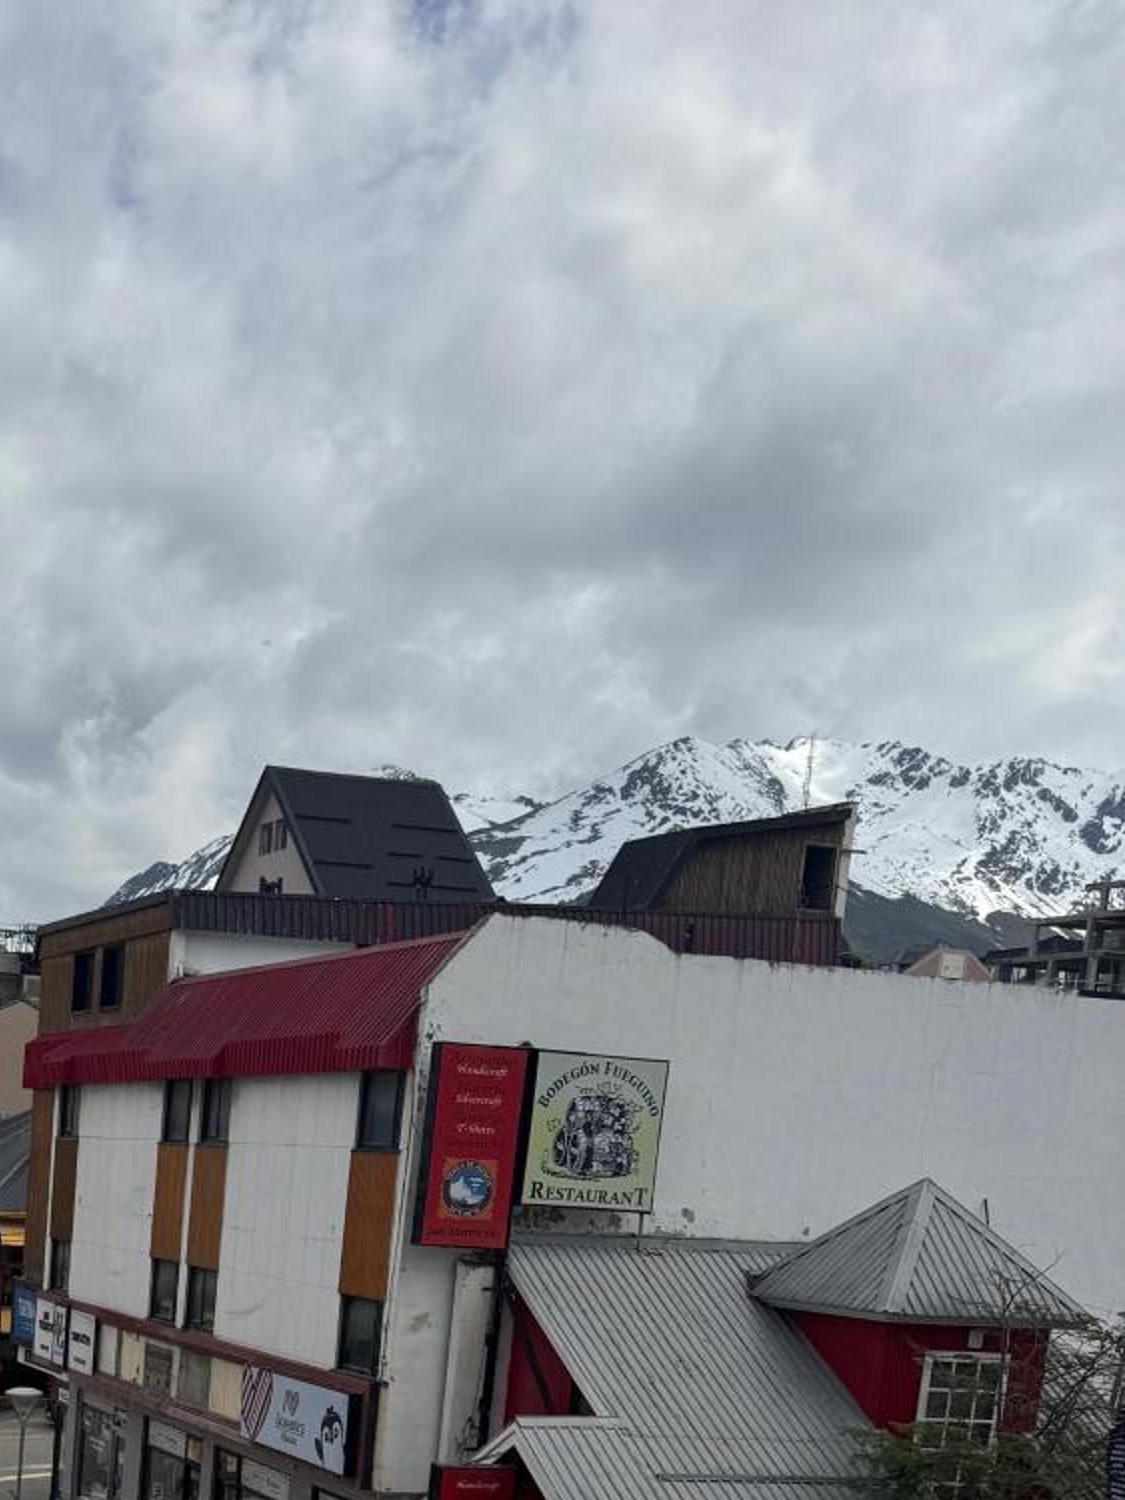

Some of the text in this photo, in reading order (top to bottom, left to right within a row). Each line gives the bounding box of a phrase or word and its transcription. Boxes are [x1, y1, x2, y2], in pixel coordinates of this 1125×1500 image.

[538, 1061, 660, 1117] BODEGÓN FUEGUINO
[531, 1181, 648, 1206] RESTAURANT
